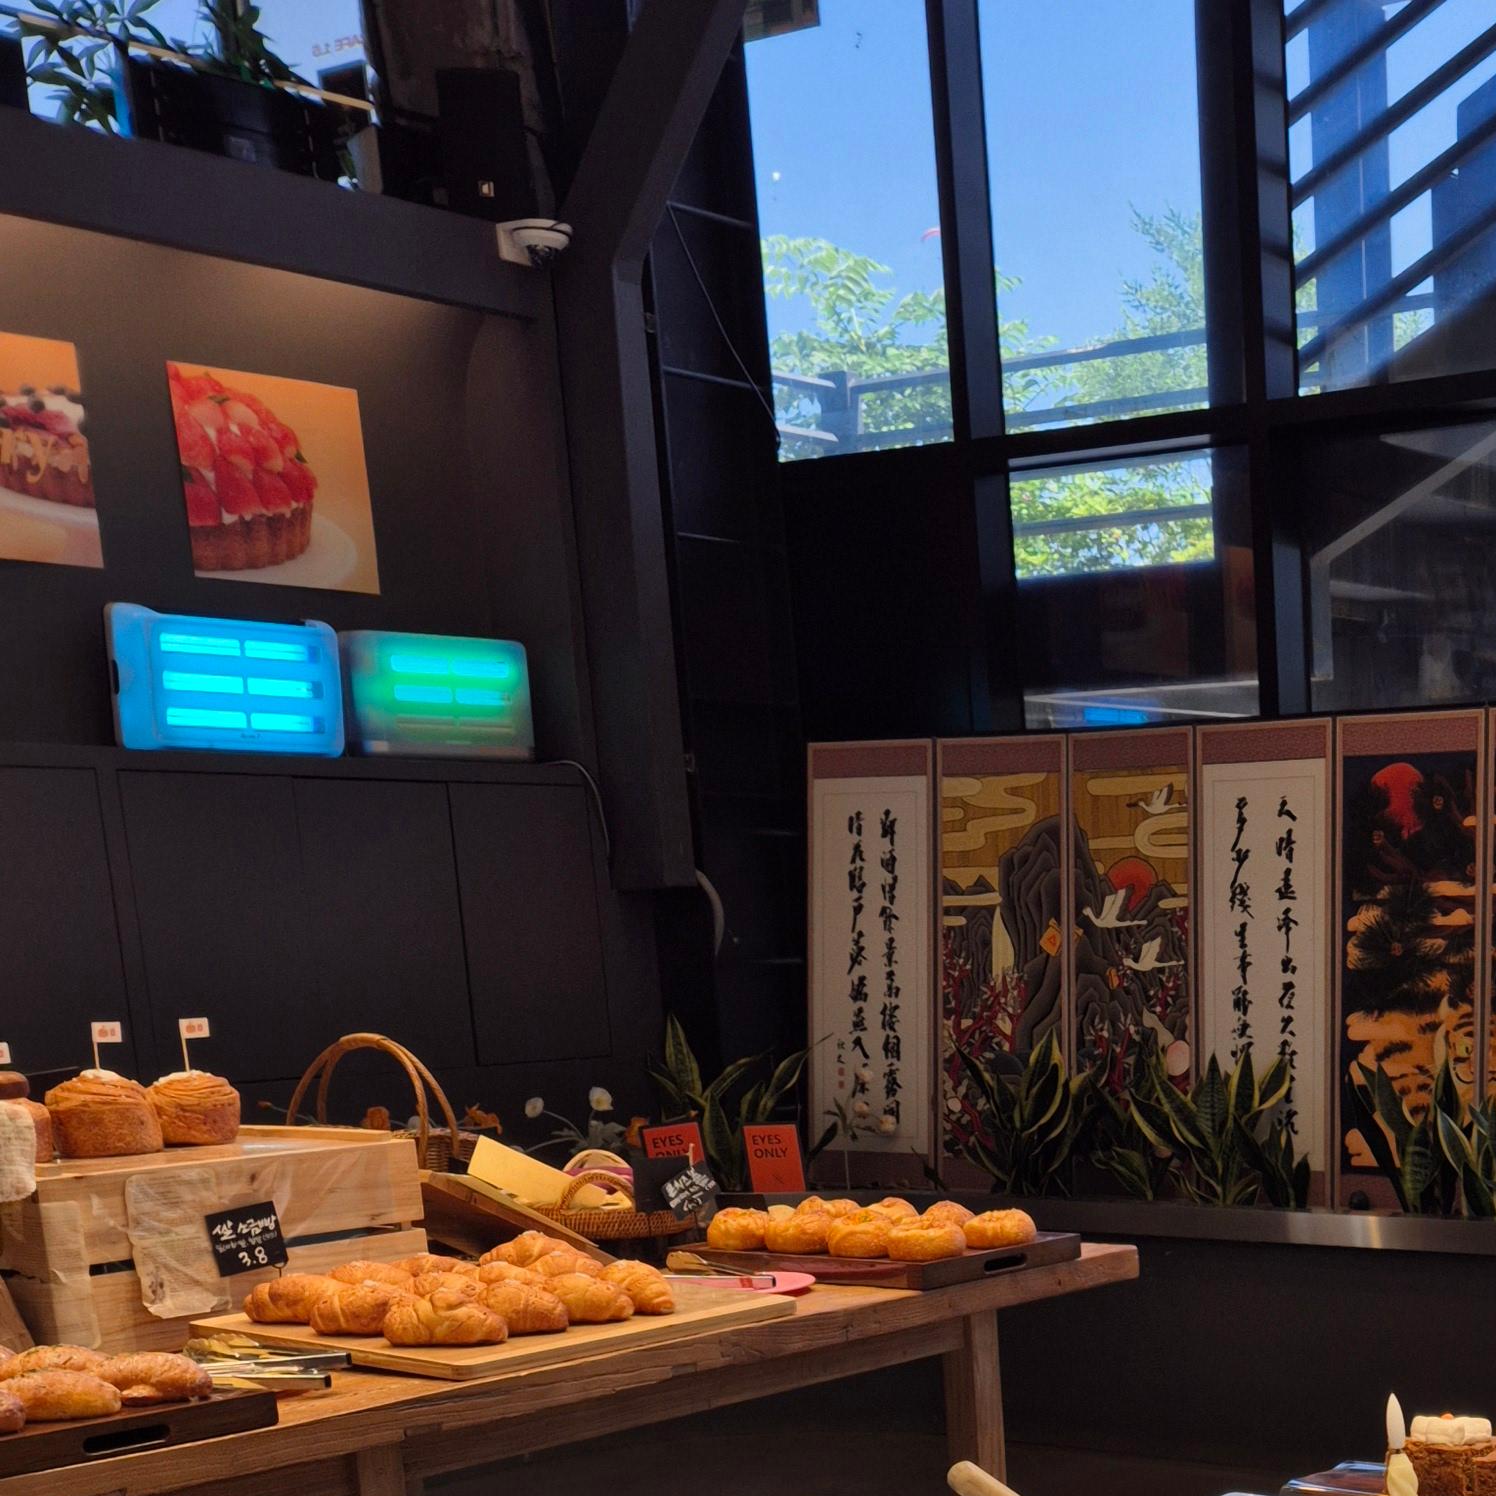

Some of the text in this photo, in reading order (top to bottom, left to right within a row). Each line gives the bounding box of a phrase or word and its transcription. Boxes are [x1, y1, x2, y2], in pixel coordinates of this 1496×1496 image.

[652, 1135, 684, 1148] EYES
[752, 1135, 782, 1145] EYES
[754, 1147, 788, 1158] ONLY
[238, 1246, 268, 1267] 3.8
